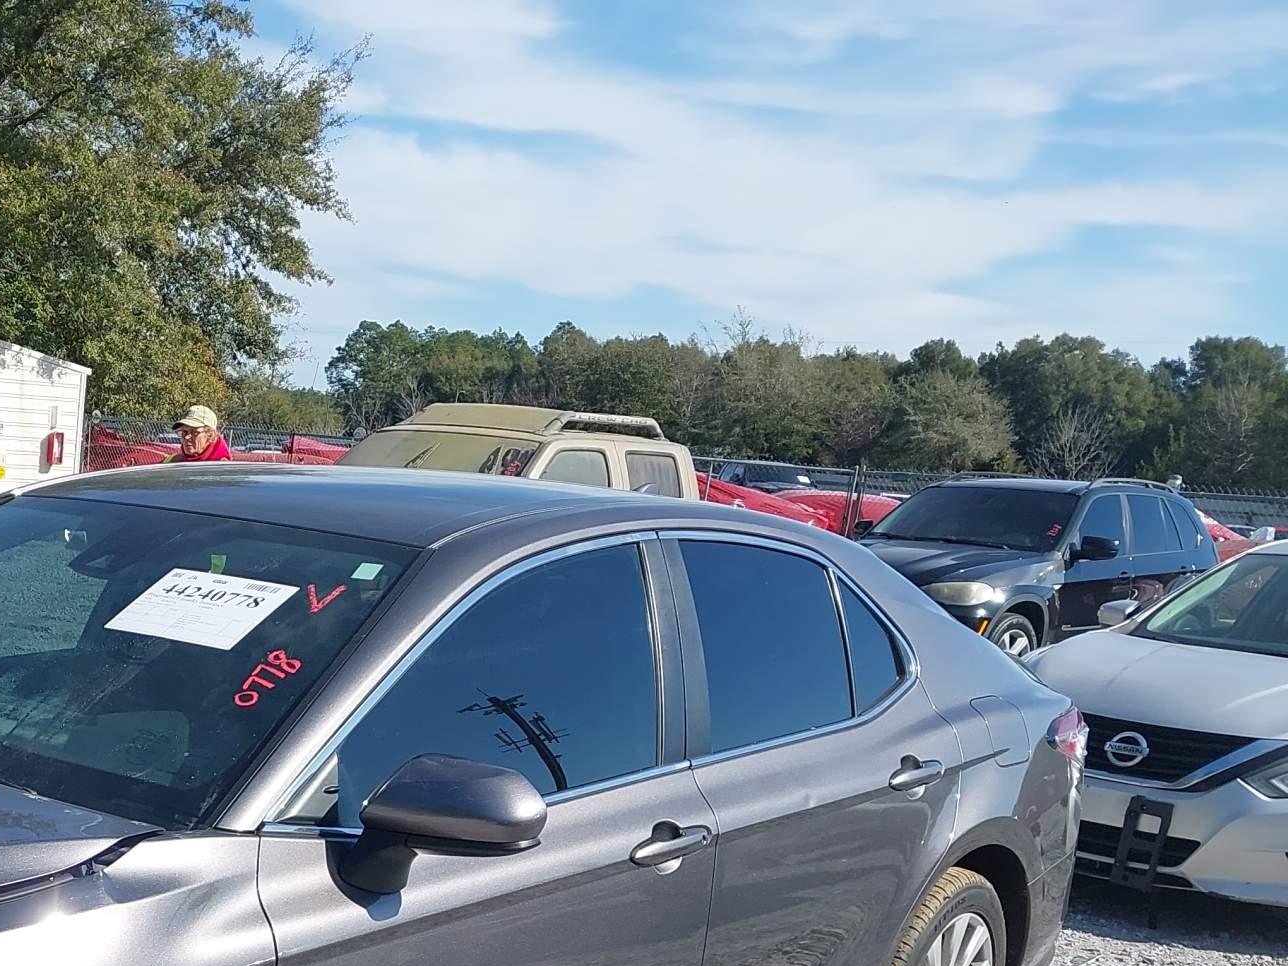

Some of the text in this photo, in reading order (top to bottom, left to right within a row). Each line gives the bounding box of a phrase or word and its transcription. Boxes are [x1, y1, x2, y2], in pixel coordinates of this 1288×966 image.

[162, 583, 266, 609] 44240778
[234, 650, 301, 706] 0778
[1107, 743, 1145, 754] NISSAN
